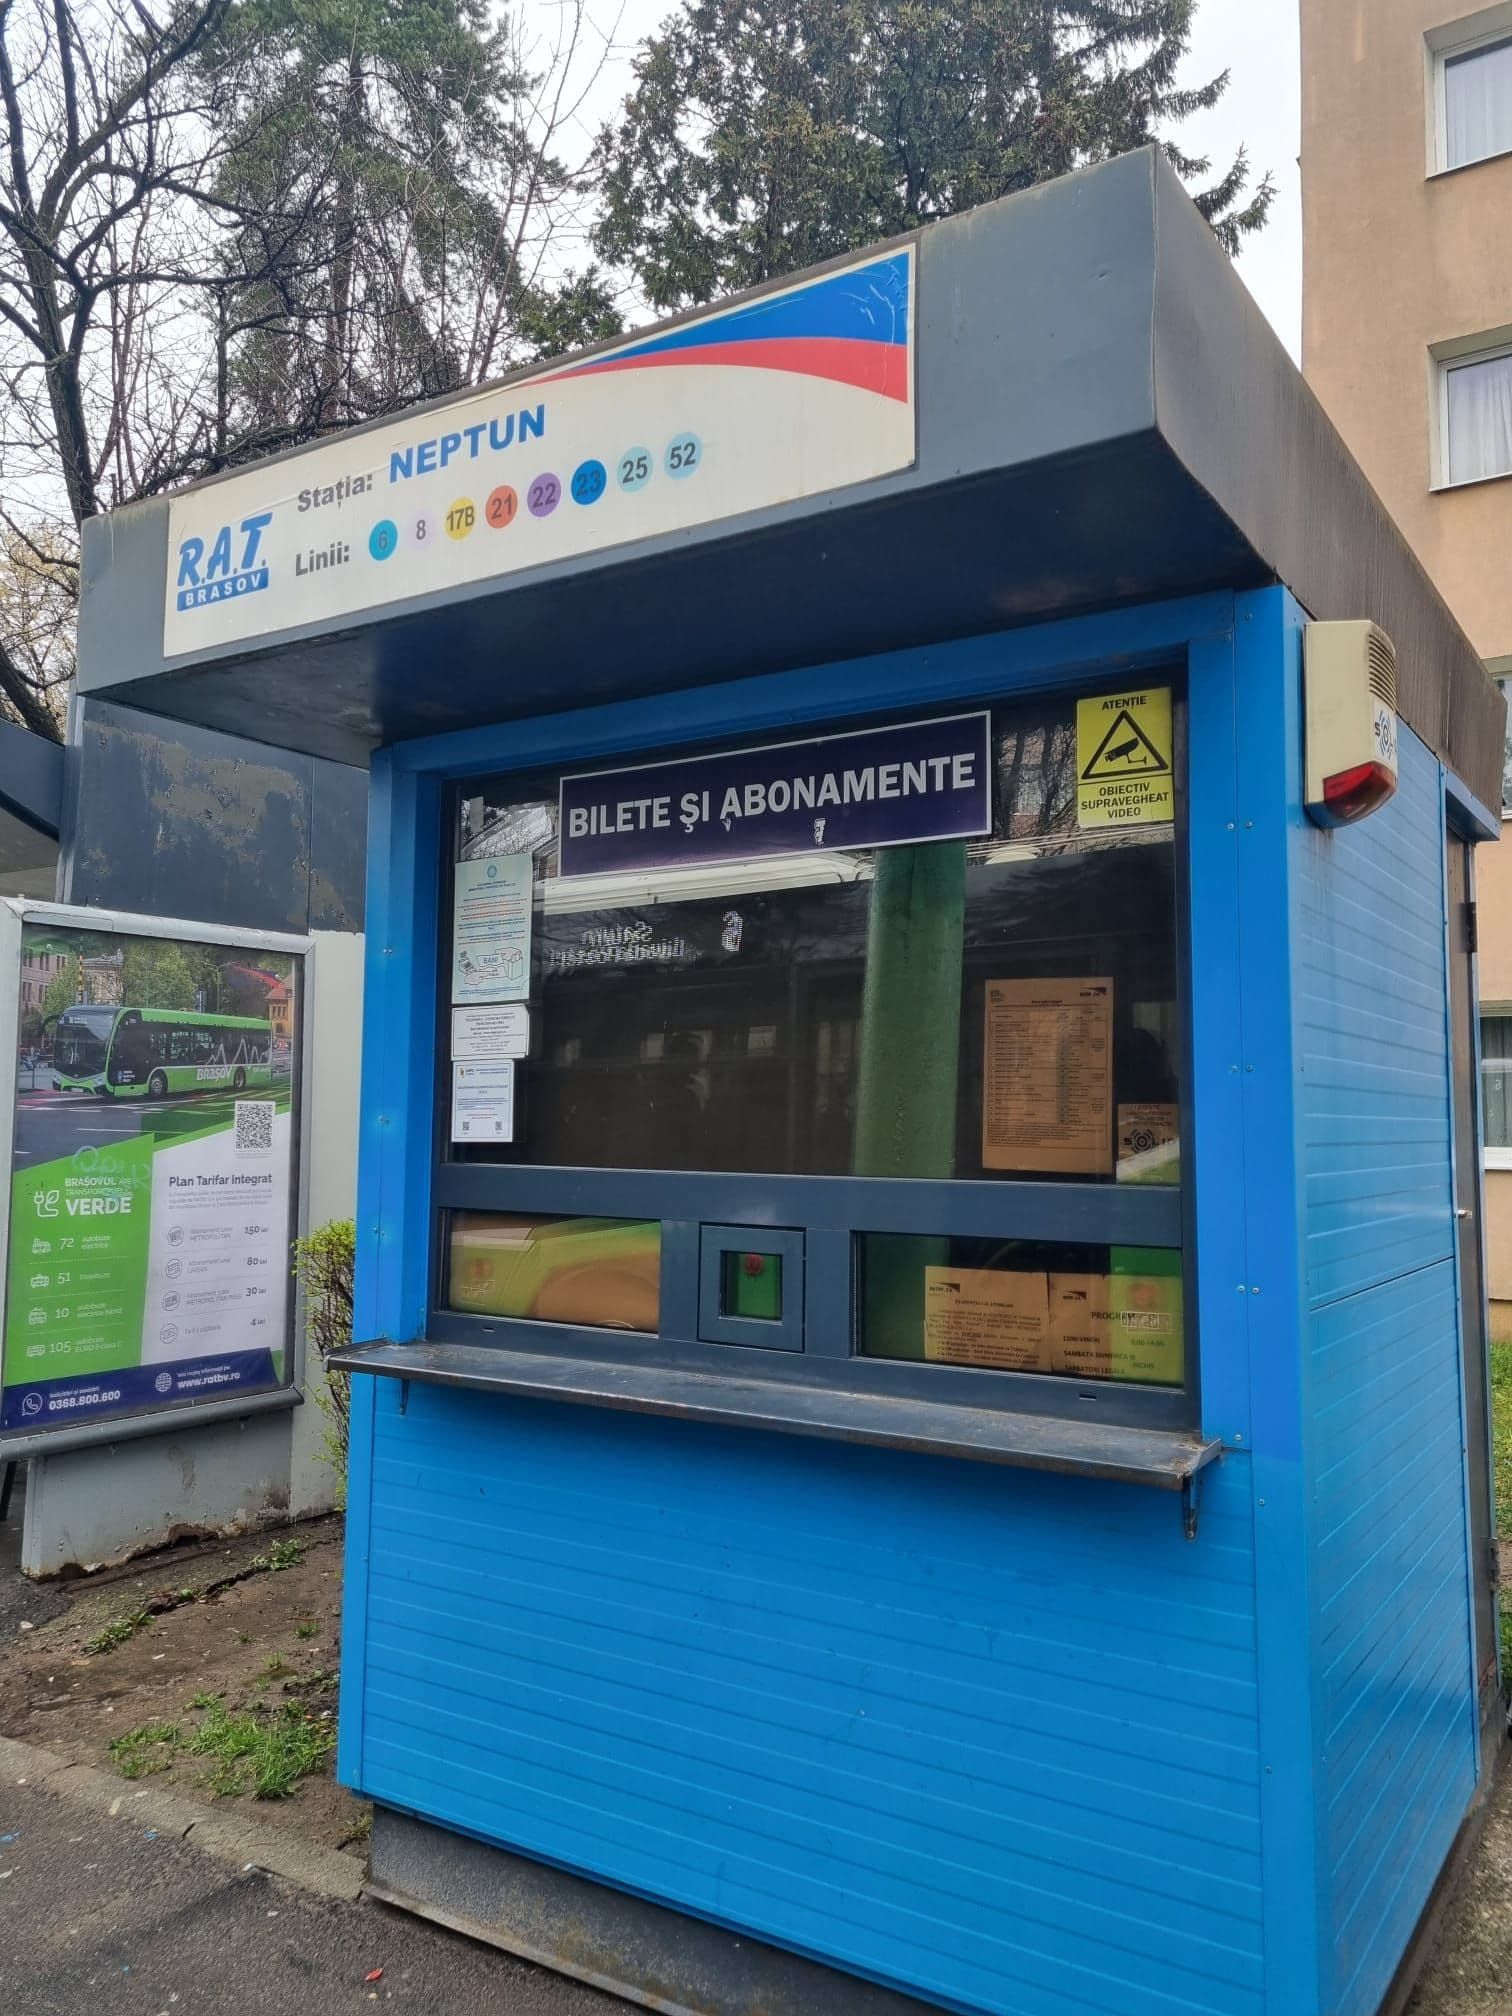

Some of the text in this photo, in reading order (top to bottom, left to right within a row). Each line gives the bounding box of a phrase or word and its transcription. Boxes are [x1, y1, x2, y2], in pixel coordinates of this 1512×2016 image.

[389, 404, 545, 483] NEPTUN
[295, 441, 697, 577] Linii: 6 8 17B 21 22 23 25 52
[185, 572, 262, 608] BRASOV
[569, 796, 670, 838] BILETE
[720, 752, 976, 820] ABONAMENTE
[1099, 782, 1151, 797] OBIECTIV
[1081, 791, 1169, 811] SUPRAVEGHEAT
[1107, 806, 1142, 819] VIDEO
[168, 1172, 273, 1188] Plan Tarifar Integrat
[64, 1196, 132, 1217] VERDE
[244, 1225, 260, 1236] 150
[59, 1237, 75, 1250] 72
[246, 1256, 259, 1267] 80
[57, 1272, 72, 1285] 51
[245, 1286, 258, 1297] 30
[55, 1307, 69, 1319] 10
[250, 1317, 257, 1327] 4
[48, 1340, 72, 1354] 105
[177, 1371, 241, 1390] www.ratbv.ro
[49, 1389, 121, 1411] 0368.800.600
